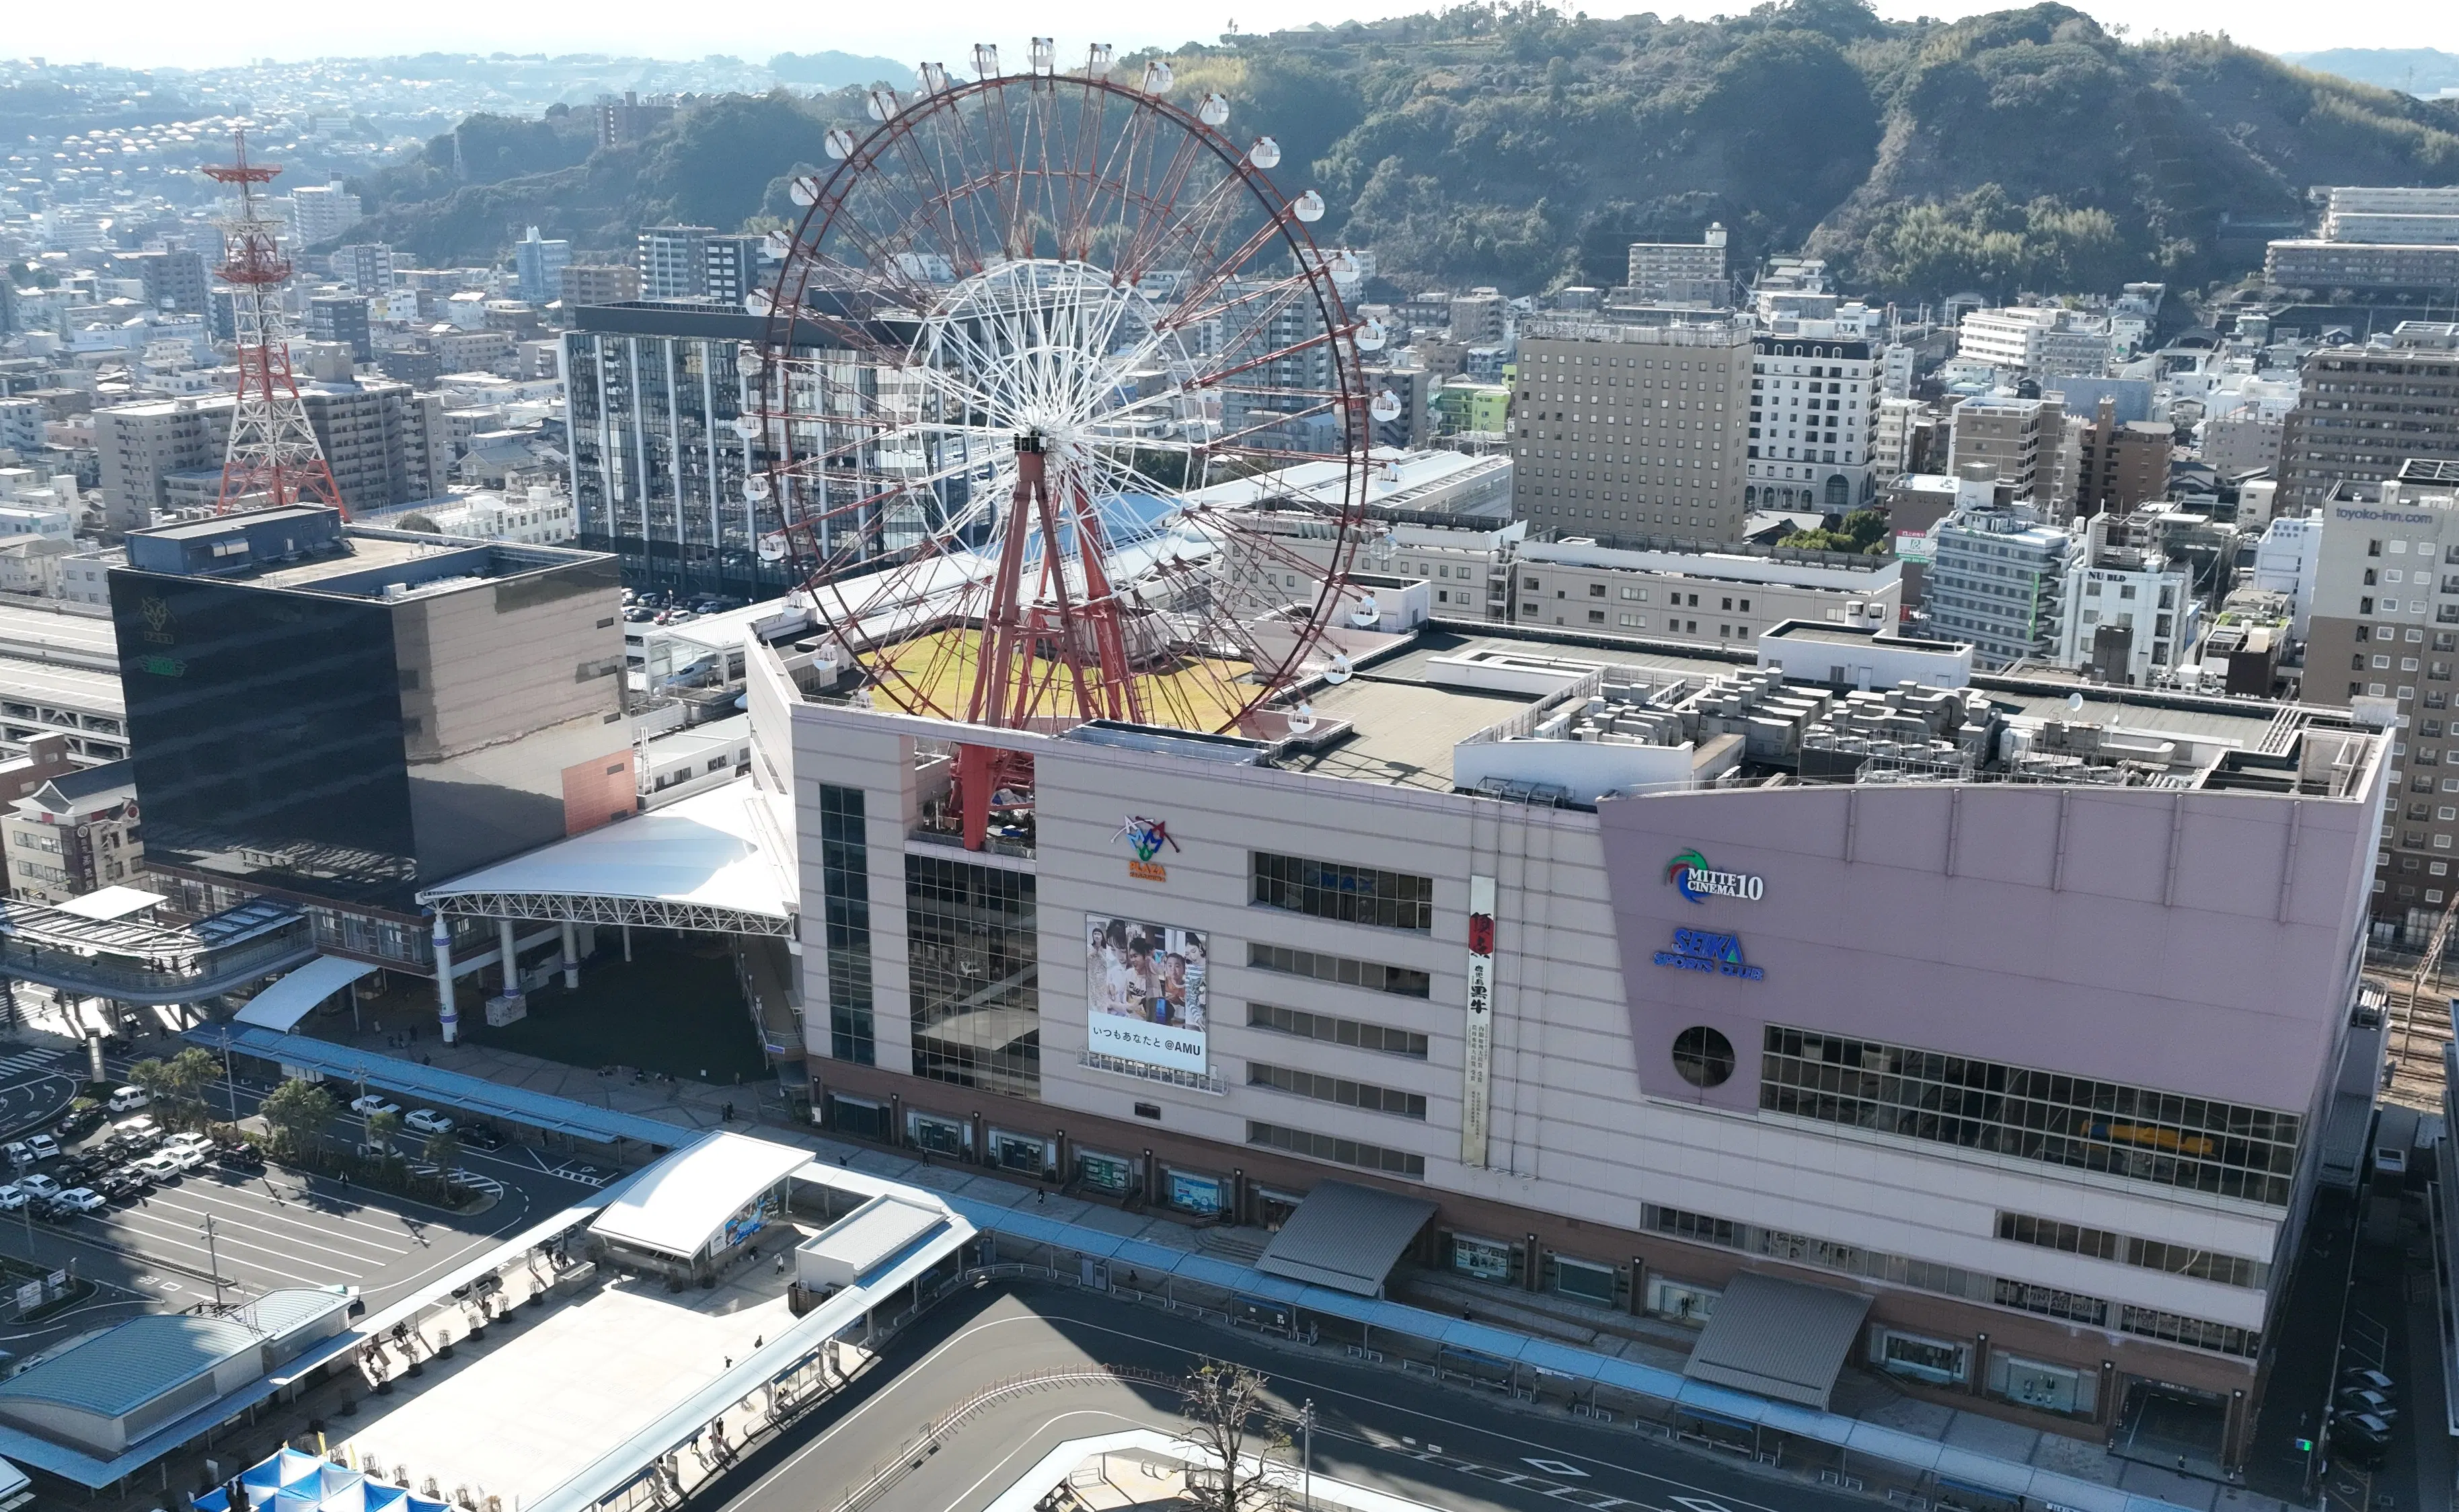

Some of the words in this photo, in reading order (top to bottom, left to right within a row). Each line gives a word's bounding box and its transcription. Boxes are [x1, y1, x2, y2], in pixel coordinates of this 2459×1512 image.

[2336, 507, 2433, 524] toyoko-inn.com
[1129, 861, 1166, 876] PLAZA
[1688, 868, 1737, 886] MITTE
[1687, 880, 1735, 897] CINEMA
[1736, 874, 1764, 901] 10
[1671, 928, 1744, 964] SEIKA
[1653, 952, 1714, 973] SPORTS
[1719, 963, 1765, 982] CLUB
[1093, 1026, 1161, 1047] いつもあなたと
[1165, 1040, 1201, 1056] @AMU
[137, 1275, 184, 1292] 出口
